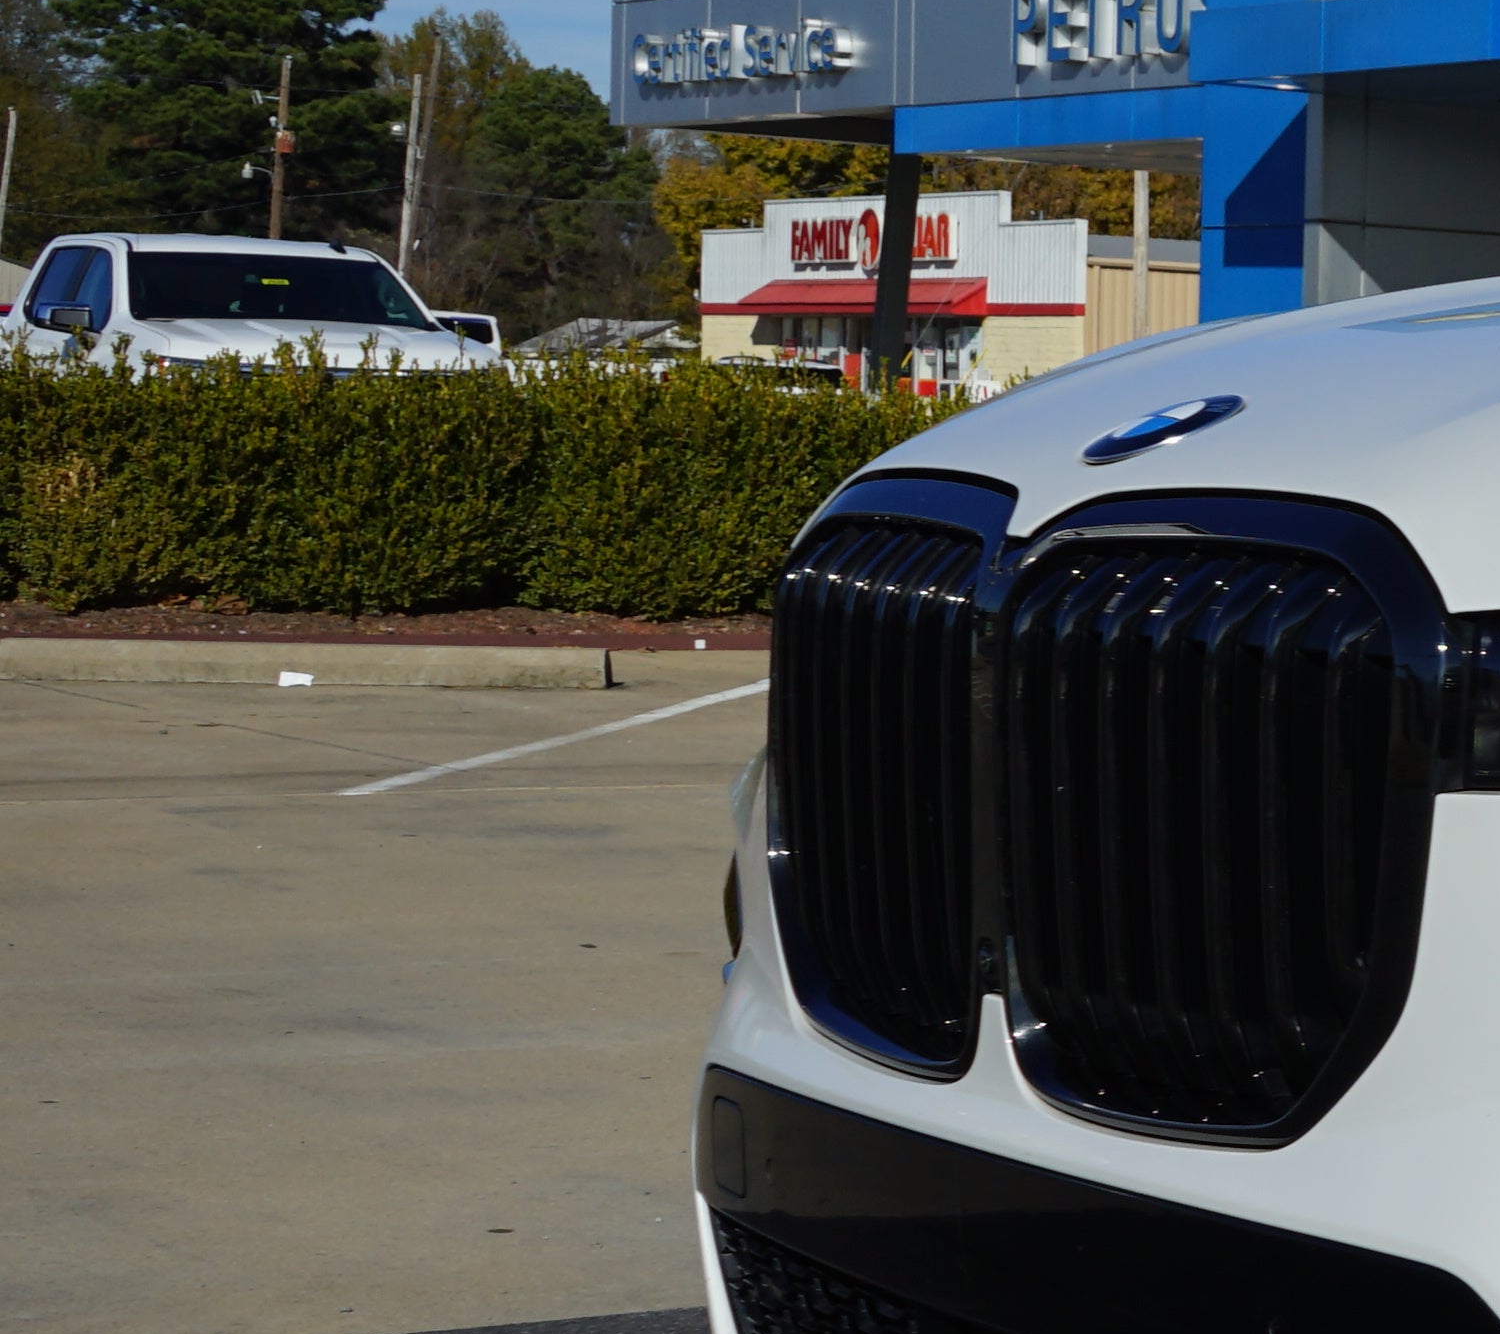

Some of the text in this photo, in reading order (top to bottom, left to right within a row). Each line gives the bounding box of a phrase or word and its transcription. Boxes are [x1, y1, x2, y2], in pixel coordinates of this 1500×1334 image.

[633, 18, 853, 84] Certified Service
[791, 218, 854, 261] FAMILY
